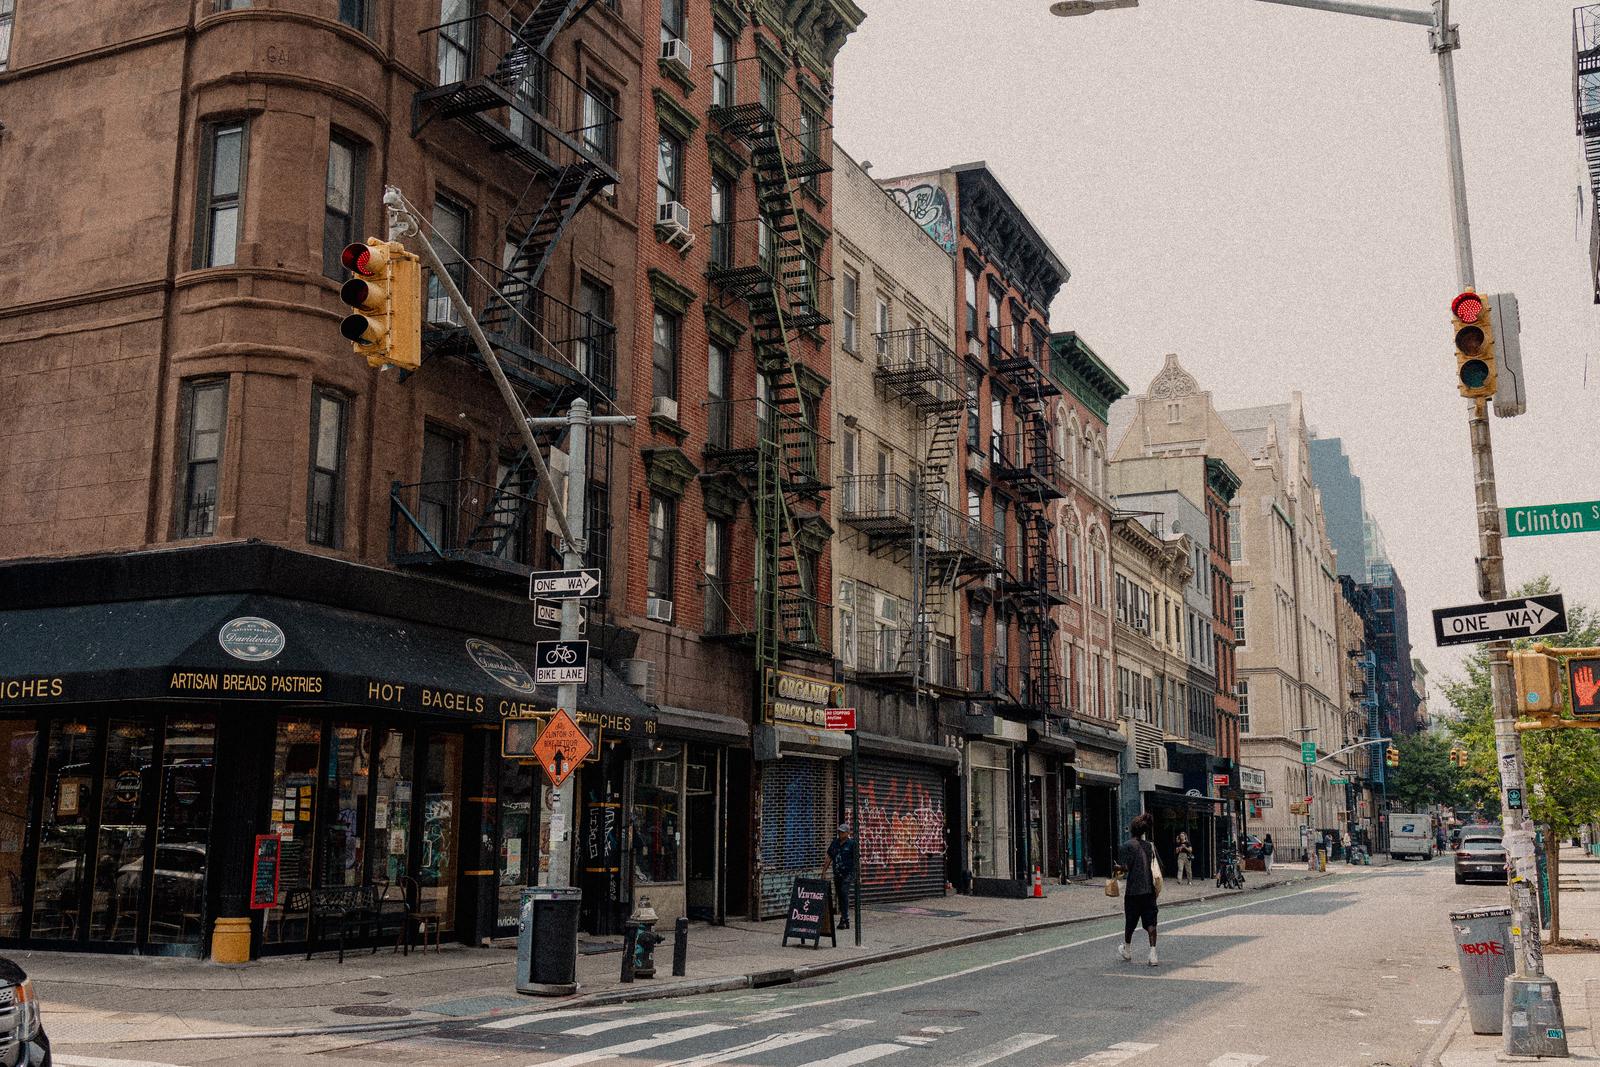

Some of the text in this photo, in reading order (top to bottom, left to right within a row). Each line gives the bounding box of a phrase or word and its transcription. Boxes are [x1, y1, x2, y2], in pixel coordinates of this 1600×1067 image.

[1514, 505, 1600, 533] Clinton S
[536, 578, 590, 592] ONE WAY
[539, 606, 555, 620] ONE
[1452, 608, 1544, 634] ONE WAY
[538, 669, 583, 680] BIKE LANE
[170, 672, 322, 693] ARTISAN BREADS PASTRIES
[368, 682, 405, 703] HOT
[421, 690, 484, 713] BAGELS
[779, 676, 830, 705] ORGANIC
[774, 702, 806, 723] SNACKS
[545, 730, 568, 738] CLINTON
[643, 720, 657, 735] 161
[797, 886, 824, 901] VINTAGE
[791, 908, 819, 923] DESIGNER
